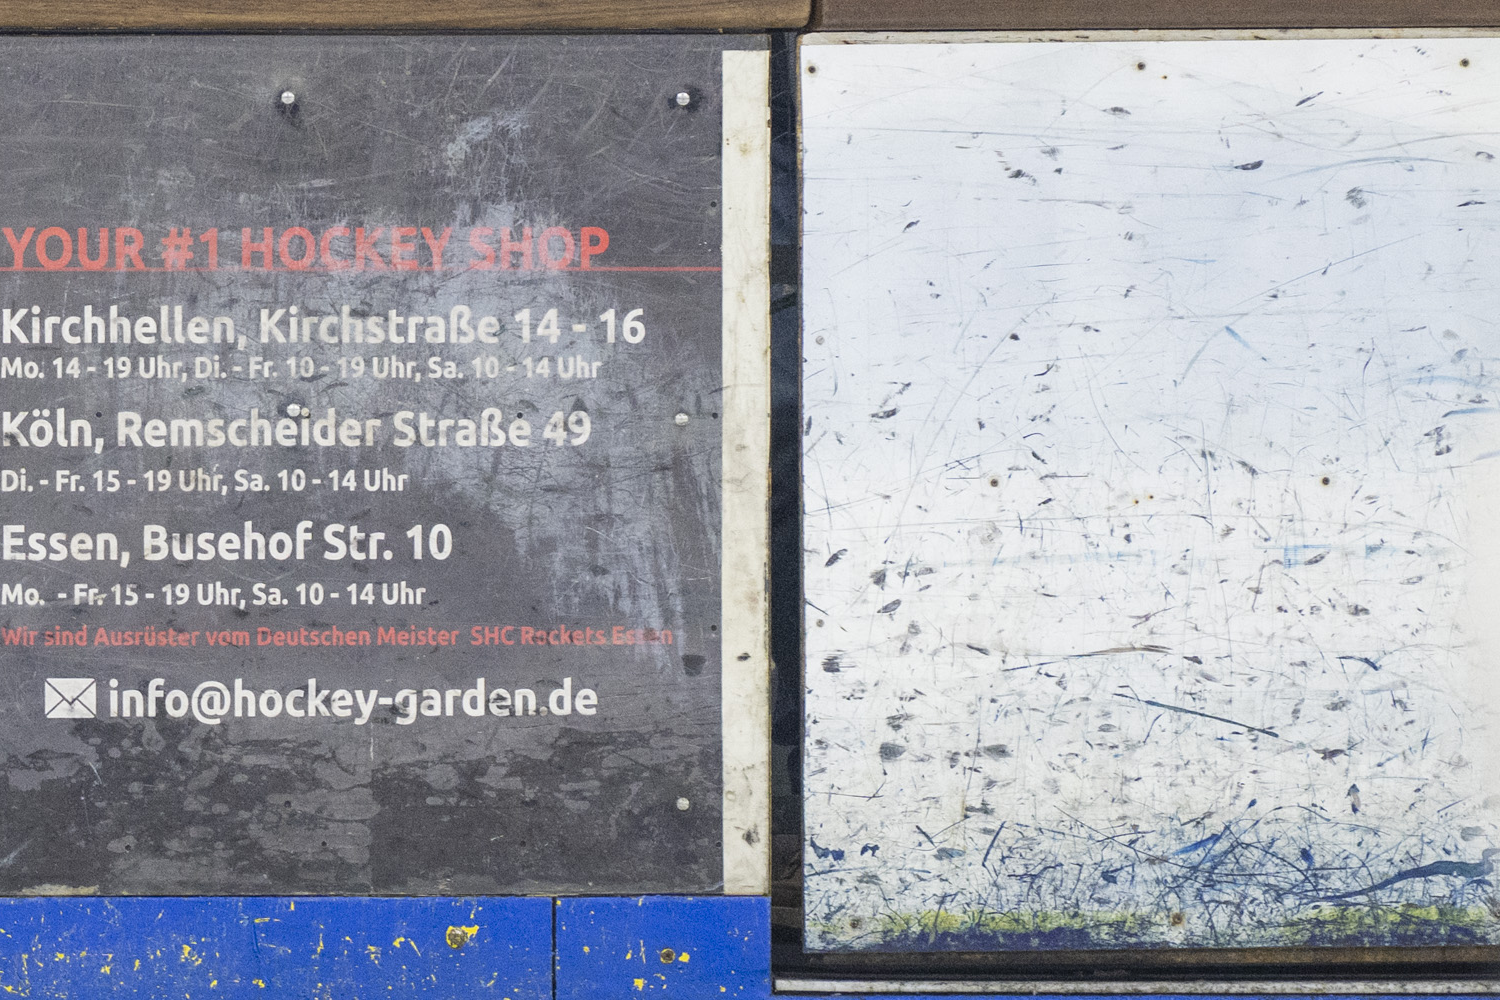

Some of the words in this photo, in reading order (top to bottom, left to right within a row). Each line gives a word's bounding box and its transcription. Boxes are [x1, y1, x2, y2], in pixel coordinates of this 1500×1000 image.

[2, 227, 147, 271] YOUR
[161, 227, 219, 271] #1
[241, 227, 453, 271] HOCKEY
[469, 227, 611, 271] SHOP
[2, 304, 247, 351] Kirchhellen,
[260, 304, 501, 344] Kirchstraße
[514, 308, 562, 344] 14
[599, 308, 647, 344] 16
[0, 356, 46, 380] Mo.
[52, 356, 81, 380] 14
[103, 356, 132, 380] 19
[139, 355, 188, 384] Uhr,
[194, 356, 228, 380] Di.
[249, 356, 278, 380] Fr.
[286, 356, 315, 380] 10
[336, 356, 366, 380] 19
[372, 355, 422, 384] Uhr,
[427, 356, 464, 380] Sa.
[472, 356, 500, 380] 10
[523, 356, 551, 380] 14
[557, 355, 603, 380] Uhr
[2, 407, 105, 454] Köln,
[117, 407, 382, 447] Remscheider
[393, 407, 532, 447] Straße
[542, 410, 592, 447] 49
[0, 467, 34, 492] Di.
[55, 469, 86, 492] Fr.
[93, 469, 121, 492] 15
[143, 469, 172, 492] 19
[178, 467, 229, 496] Uhr,
[234, 469, 271, 492] Sa.
[277, 469, 306, 492] 10
[328, 469, 358, 492] 14
[363, 467, 409, 492] Uhr
[2, 524, 131, 567] Essen,
[143, 520, 313, 561] Busehof
[323, 524, 394, 561] Str.
[405, 524, 453, 561] 10
[0, 583, 46, 606] Mo.
[73, 583, 103, 606] Fr.
[110, 583, 139, 606] 15
[161, 583, 191, 606] 19
[196, 581, 246, 610] Uhr,
[252, 583, 289, 606] Sa.
[295, 583, 325, 606] 10
[346, 583, 376, 606] 14
[381, 581, 427, 606] Uhr
[1, 625, 39, 647] Wir
[44, 625, 88, 647] sind
[94, 625, 201, 647] Ausrüster
[204, 630, 251, 647] vom
[256, 625, 371, 647] Deutschen
[376, 625, 460, 647] Meister
[470, 625, 516, 647] SHC
[521, 625, 607, 647] Rockets
[108, 677, 598, 726] info@hockey-garden.de
